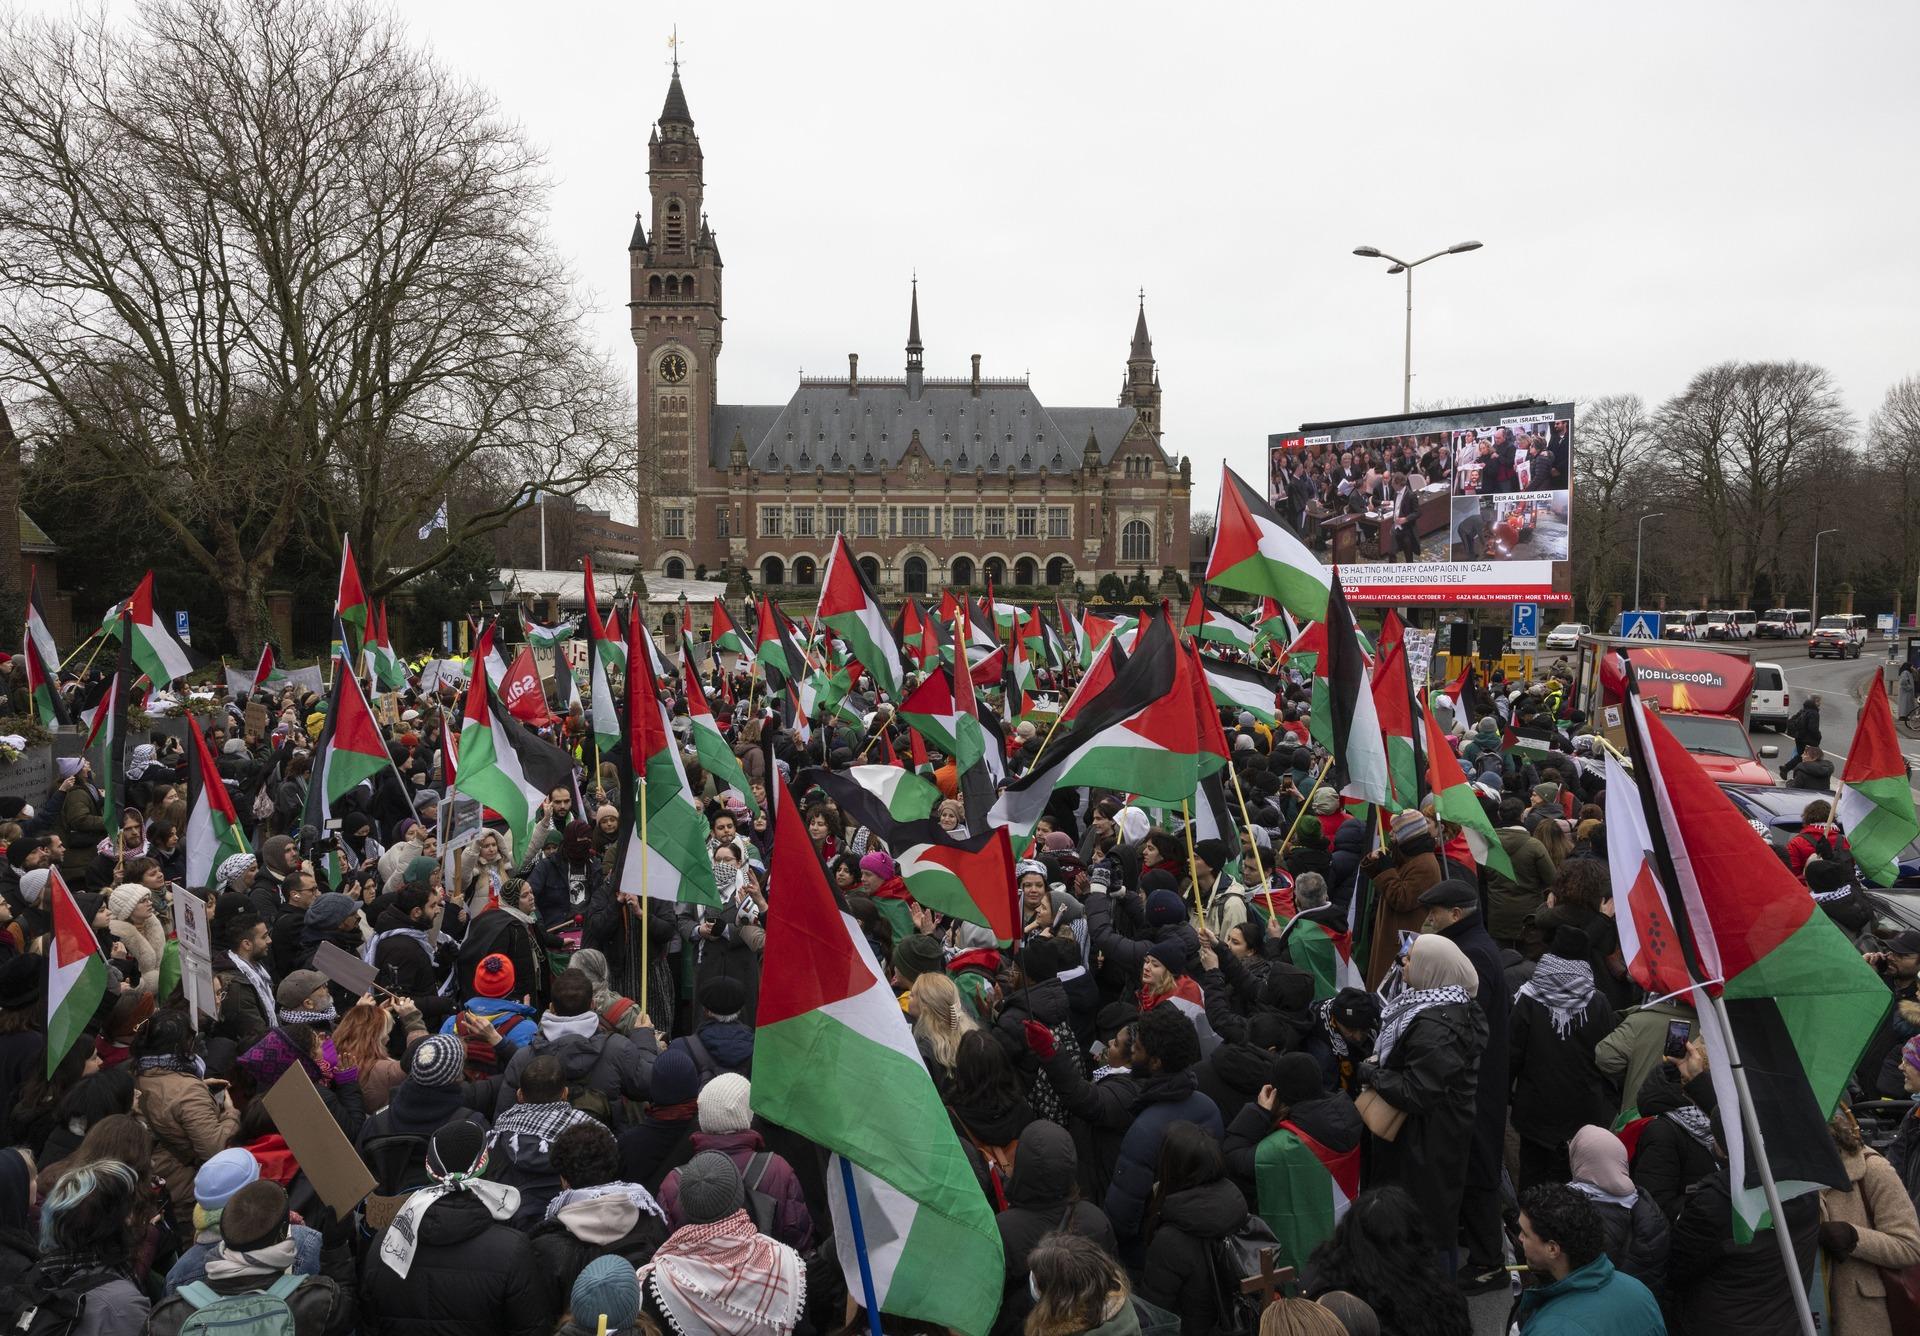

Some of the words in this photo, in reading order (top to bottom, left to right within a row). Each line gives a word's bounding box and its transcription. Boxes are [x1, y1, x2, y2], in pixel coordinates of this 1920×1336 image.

[1350, 566, 1381, 574] HALTING
[1382, 565, 1417, 574] MILITARY
[1418, 564, 1459, 574] CAMPAIGN
[1460, 564, 1469, 572] IN
[1470, 564, 1492, 572] GAZA
[1341, 576, 1363, 584] EVENT
[1364, 575, 1371, 583] IT
[1373, 575, 1393, 583] FROM
[1395, 575, 1438, 583] DEFENDING
[1440, 574, 1467, 583] ITSELF
